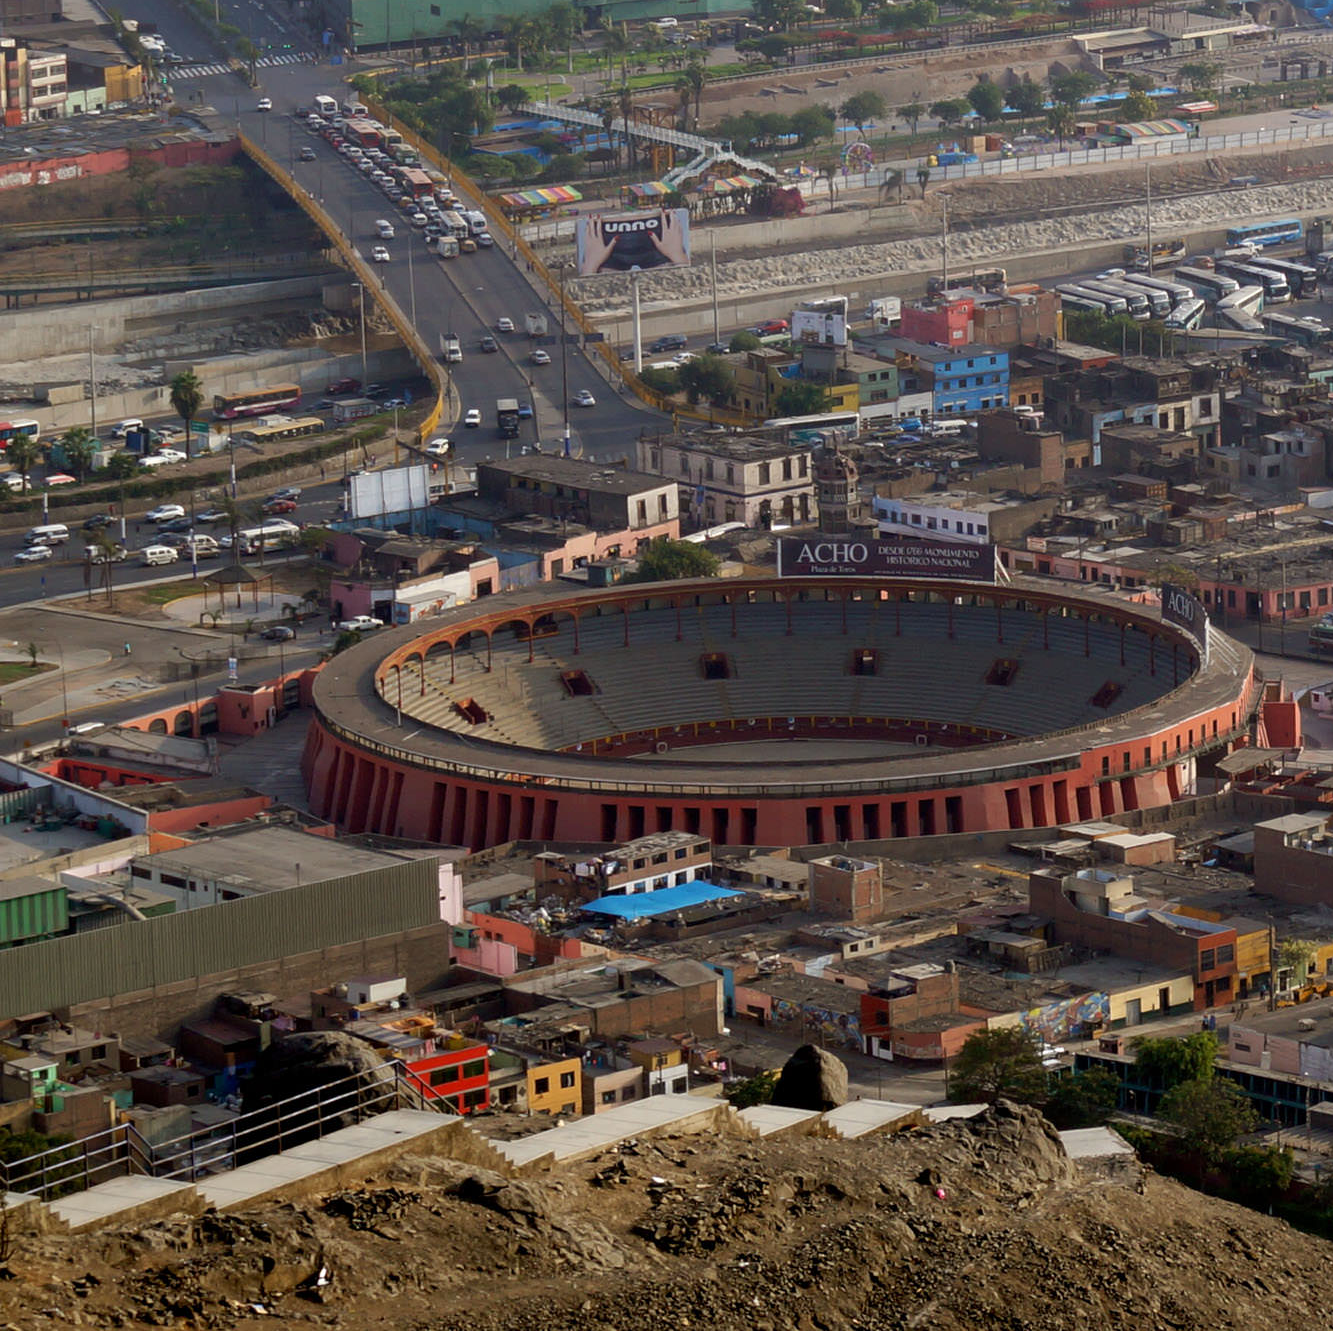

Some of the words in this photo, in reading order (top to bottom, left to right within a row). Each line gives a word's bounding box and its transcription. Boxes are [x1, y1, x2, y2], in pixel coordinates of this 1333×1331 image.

[797, 543, 868, 563] ACHO
[878, 546, 905, 555] DESDE
[924, 547, 979, 559] MONUMENTO
[931, 558, 972, 568] NACIONAL
[811, 565, 828, 573] Plaza
[829, 565, 837, 573] de
[839, 565, 856, 573] Toros
